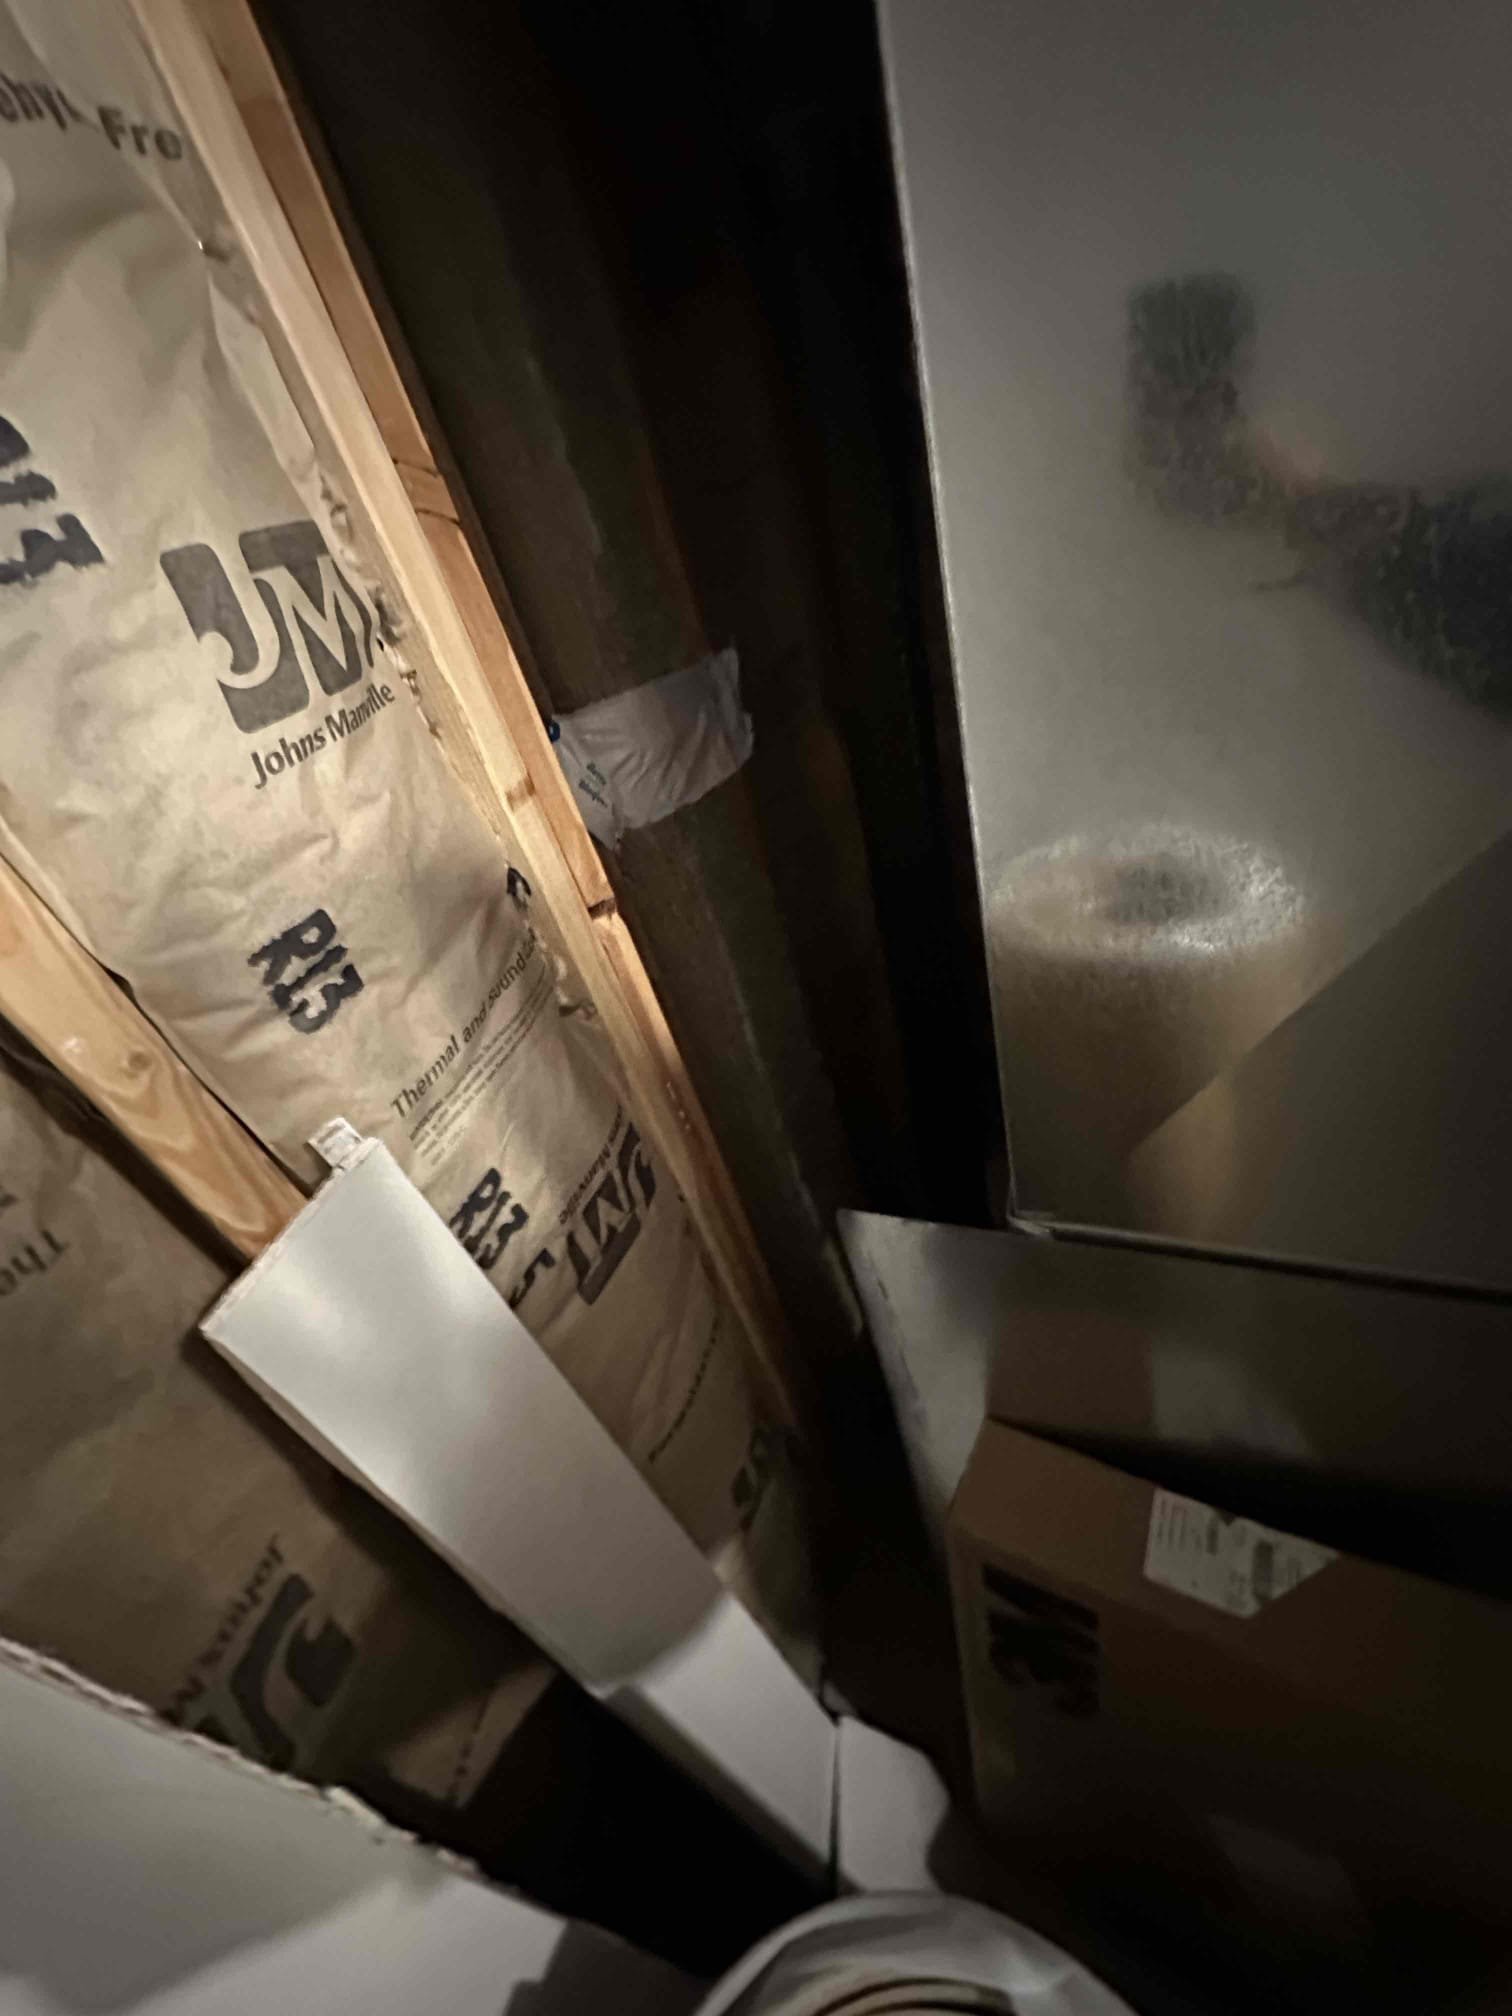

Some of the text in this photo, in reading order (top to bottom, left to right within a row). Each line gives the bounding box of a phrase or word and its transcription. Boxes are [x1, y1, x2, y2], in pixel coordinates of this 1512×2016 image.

[251, 683, 396, 790] Johns Manville
[248, 908, 364, 1035] R13
[391, 1034, 463, 1119] Thermal
[462, 991, 492, 1045] and
[487, 950, 531, 1006] sound
[450, 1167, 531, 1268] R13
